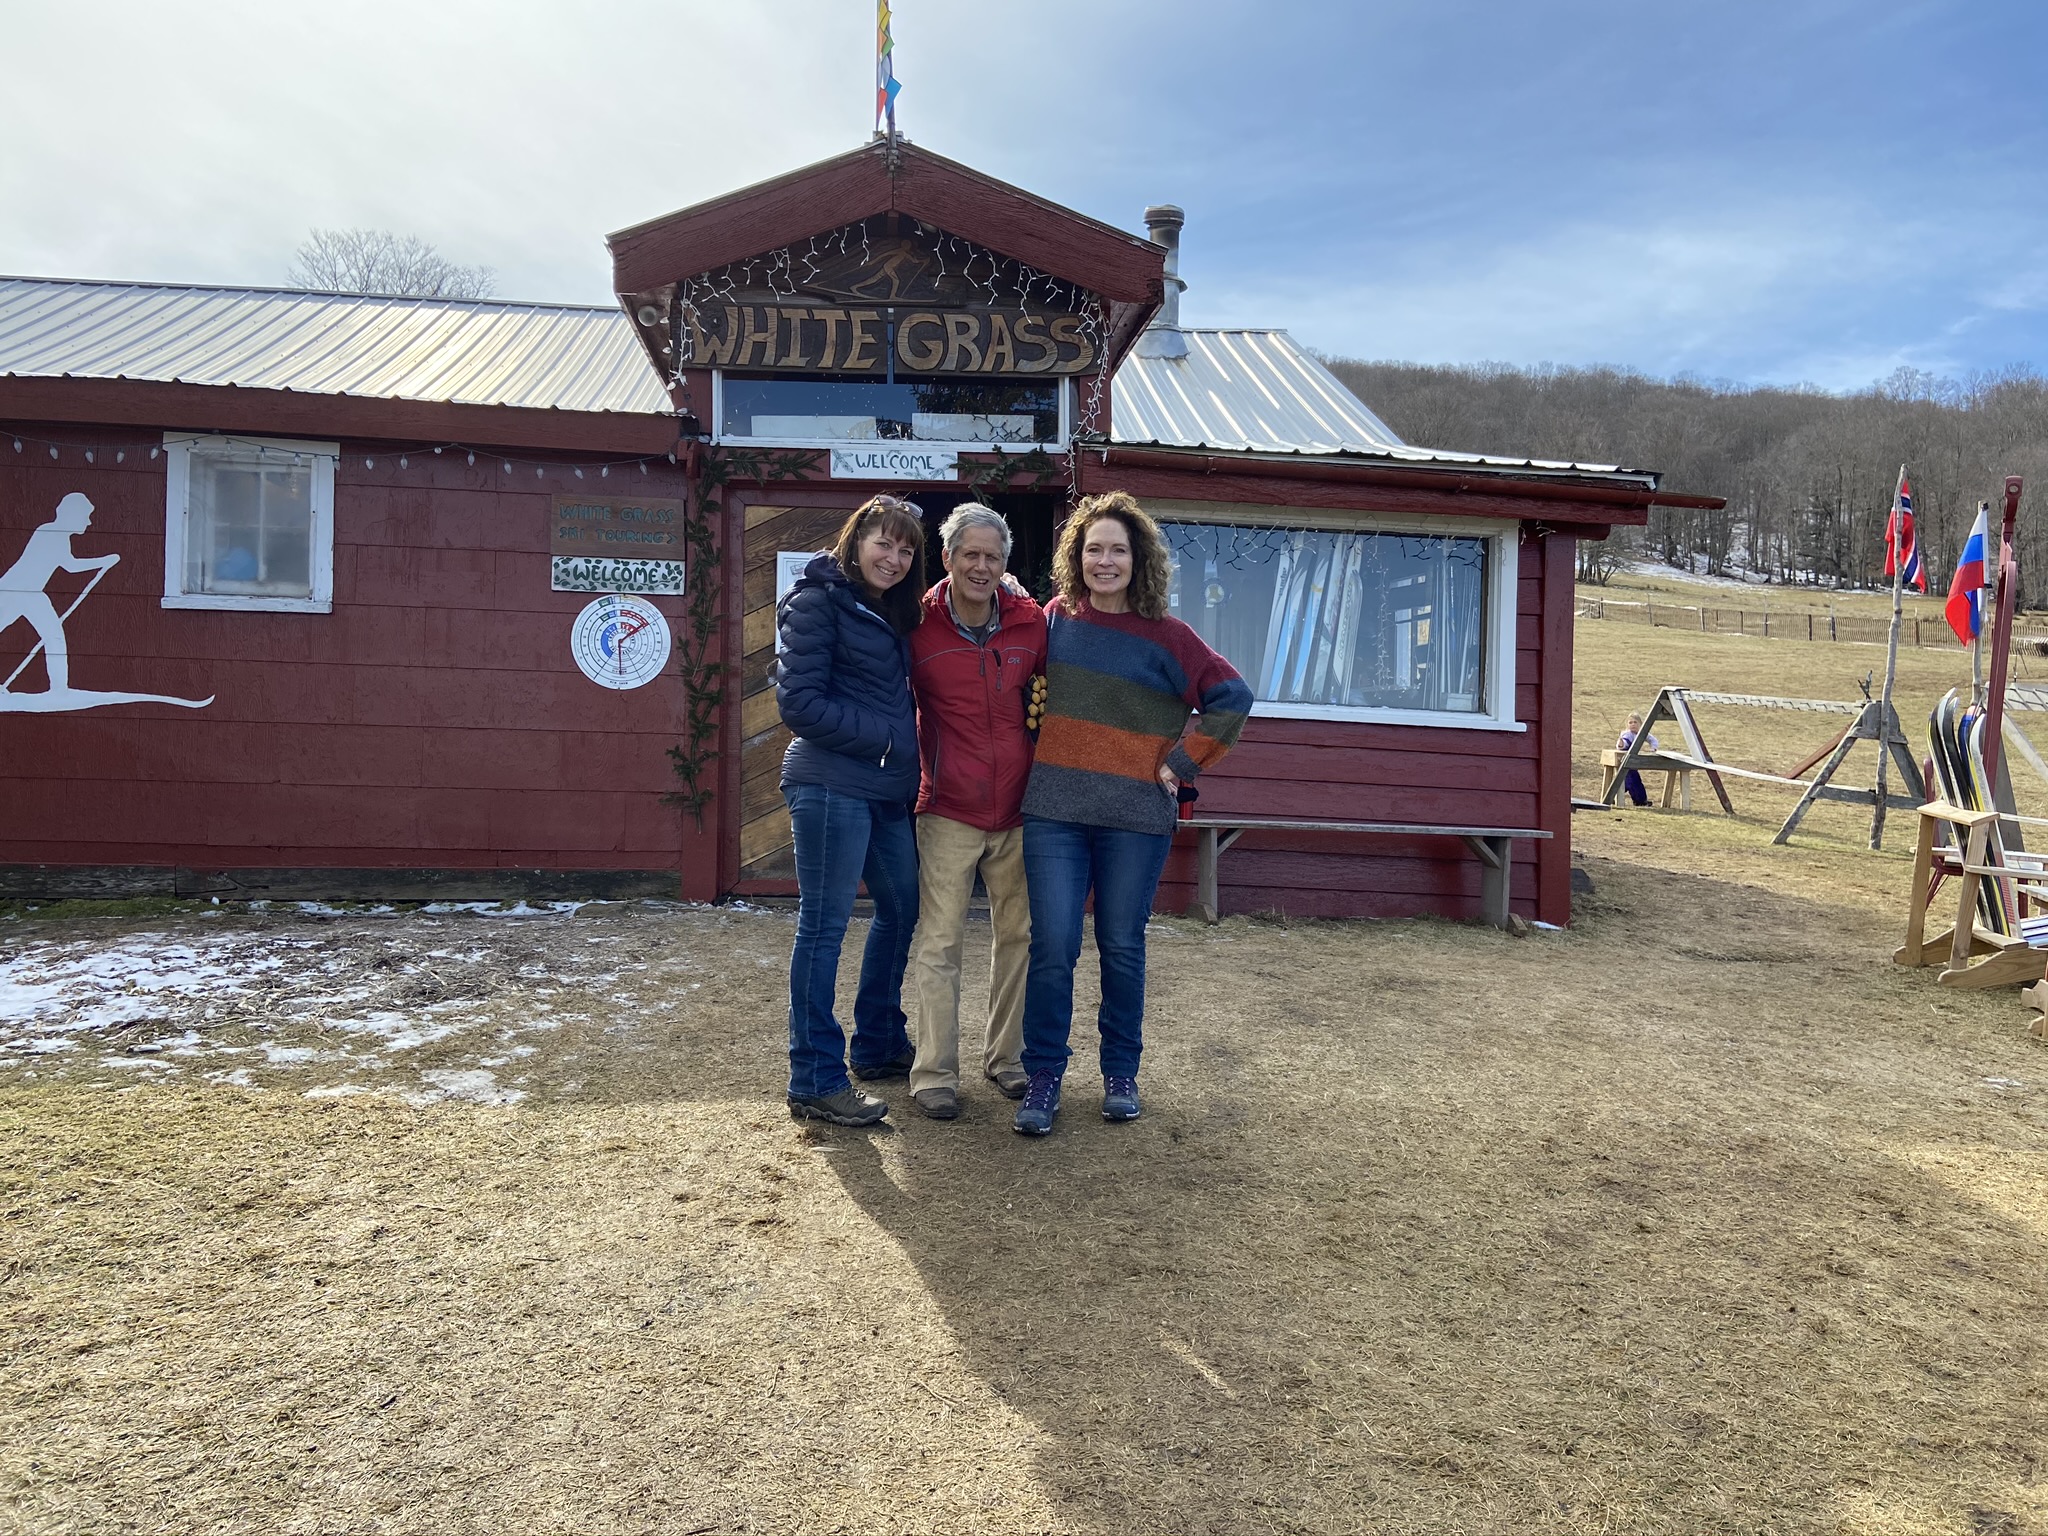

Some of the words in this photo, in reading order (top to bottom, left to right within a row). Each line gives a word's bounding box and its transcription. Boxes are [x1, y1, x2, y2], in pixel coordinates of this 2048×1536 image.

[690, 305, 881, 369] WHITE
[897, 313, 1094, 374] GRASS
[855, 453, 935, 470] WELCOME
[560, 504, 611, 521] WHITE
[621, 507, 674, 523] GRASS
[596, 528, 664, 543] TOURING
[573, 564, 658, 584] WELCOME
